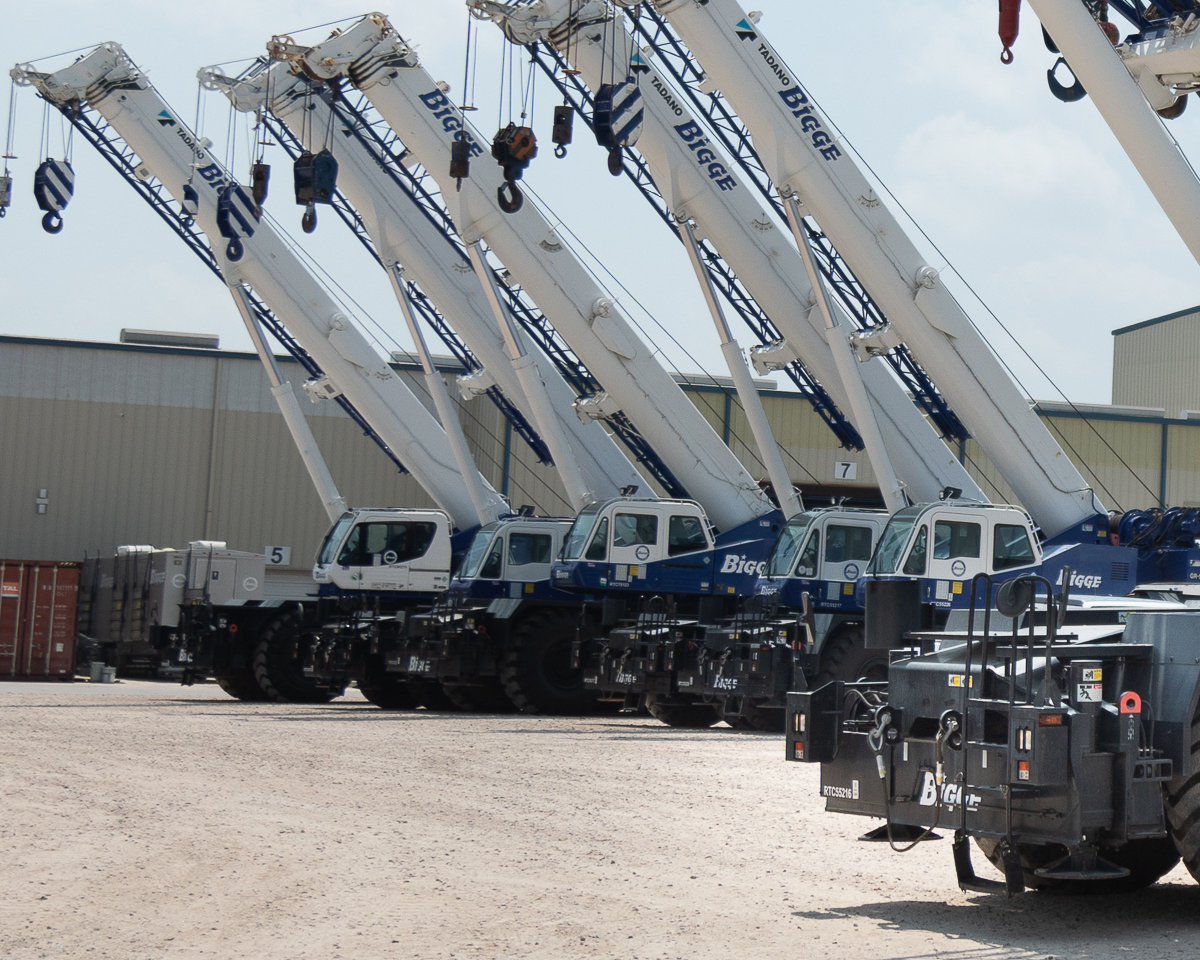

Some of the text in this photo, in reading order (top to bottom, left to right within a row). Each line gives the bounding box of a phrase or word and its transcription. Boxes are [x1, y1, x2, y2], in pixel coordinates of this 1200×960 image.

[757, 43, 790, 86] TADANO
[650, 76, 683, 117] TADANO
[176, 127, 205, 160] TADANO
[841, 462, 851, 478] 7
[270, 547, 283, 564] 5
[823, 785, 852, 799] RTC55216
